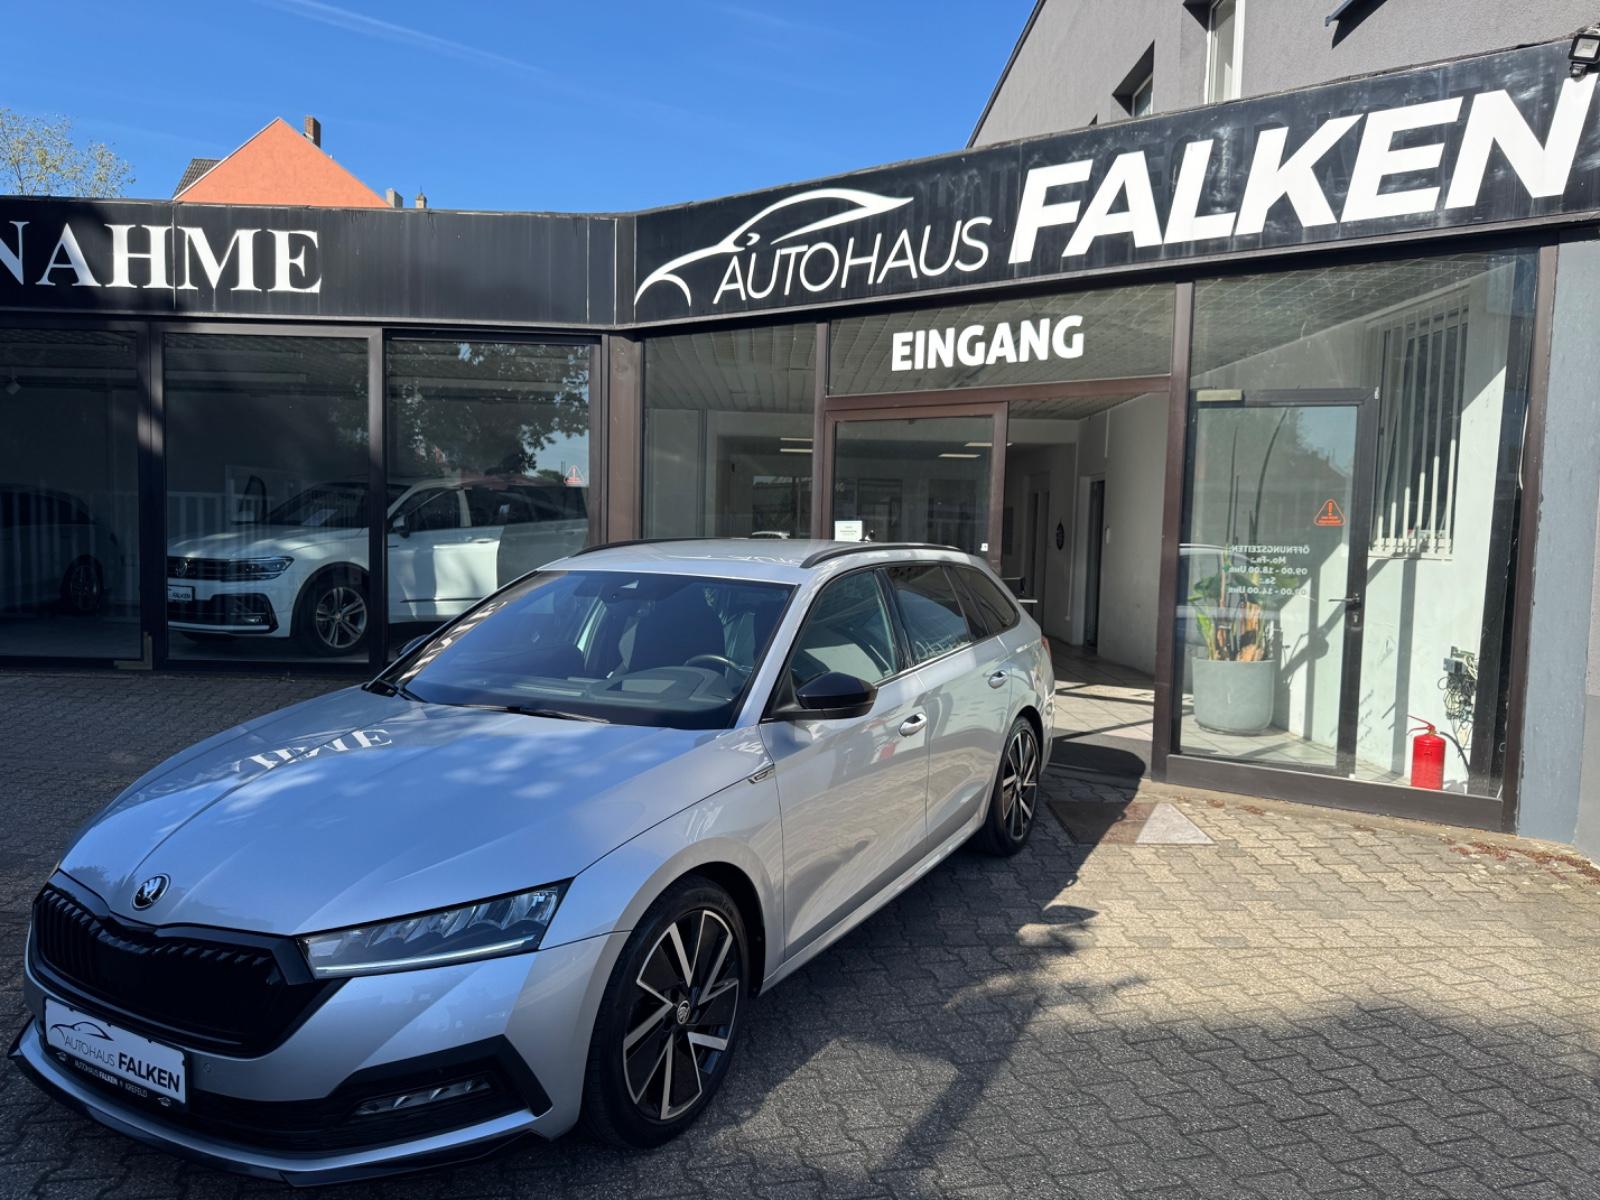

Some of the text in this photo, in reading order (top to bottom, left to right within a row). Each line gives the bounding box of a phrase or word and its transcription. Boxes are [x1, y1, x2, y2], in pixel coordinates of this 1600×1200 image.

[713, 73, 1599, 304] AUTOHAUS FALKEN
[891, 315, 1084, 371] EINGANG
[64, 1034, 180, 1093] AUTOHAUS FALKEN
